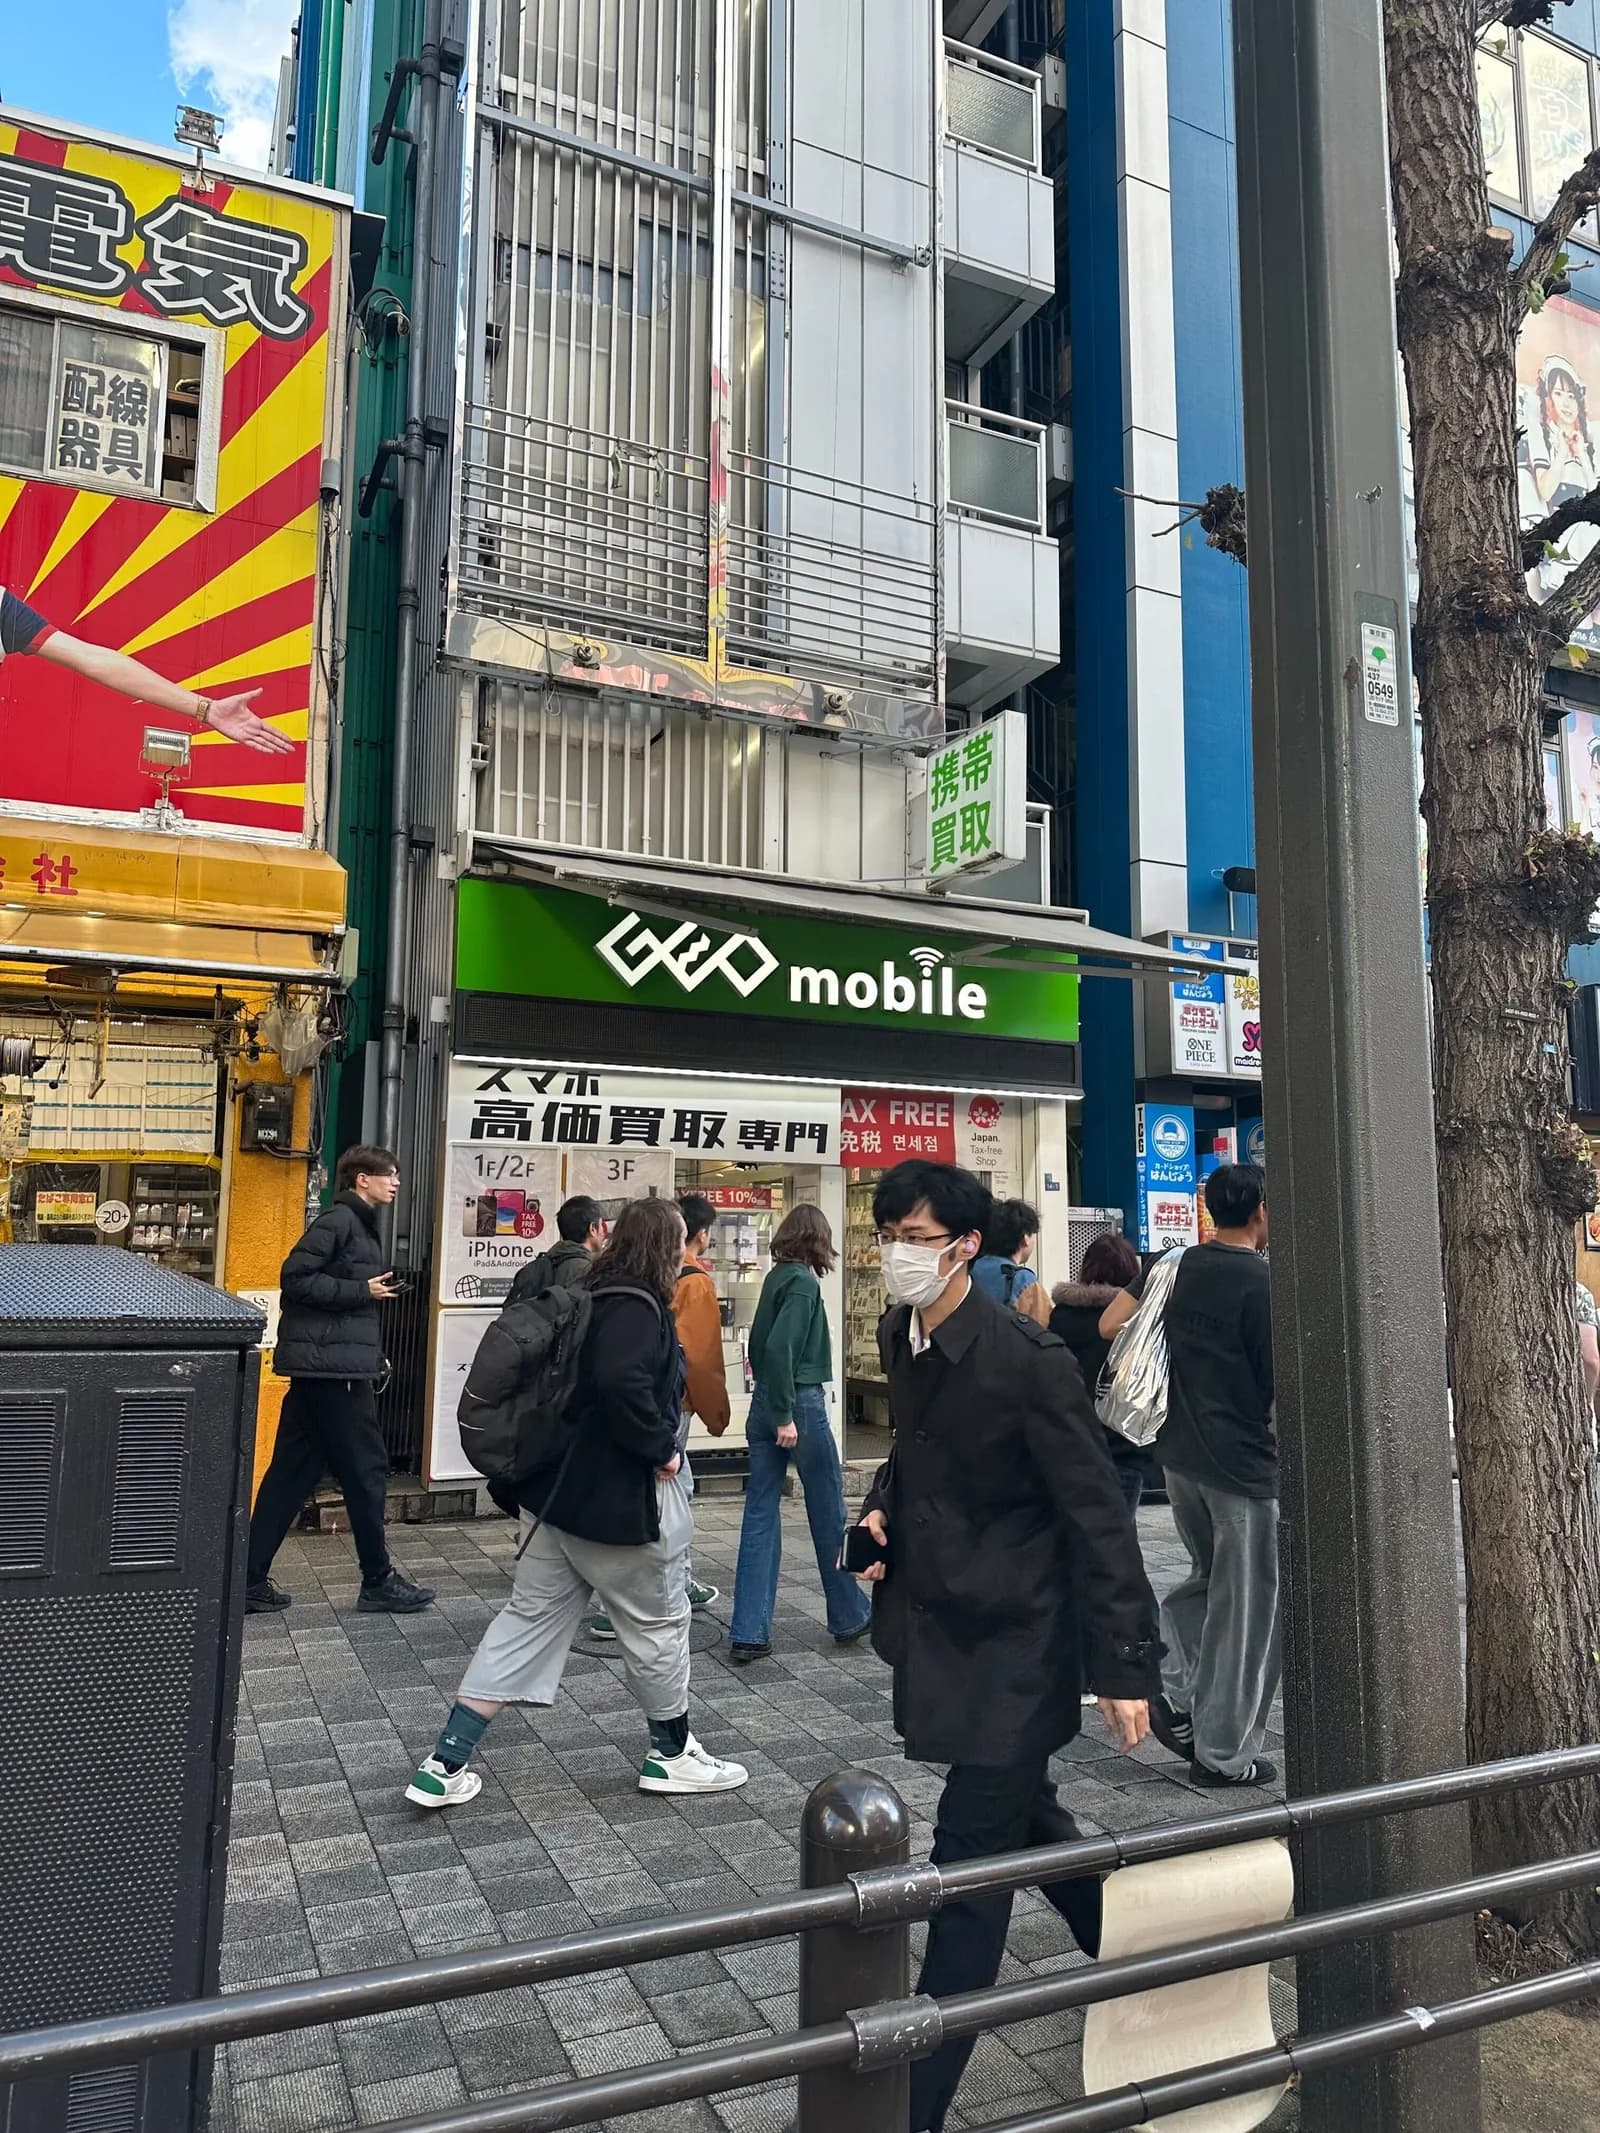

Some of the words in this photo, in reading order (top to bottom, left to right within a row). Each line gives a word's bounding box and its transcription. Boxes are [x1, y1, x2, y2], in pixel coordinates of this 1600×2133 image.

[0, 156, 313, 341] 電気
[63, 362, 150, 428] 配線
[59, 418, 143, 482] 器具
[1368, 681, 1394, 699] 0549
[931, 730, 993, 812] 携帯
[930, 800, 992, 874] 買取
[0, 853, 79, 896] 社
[596, 911, 780, 998] GEO
[790, 958, 988, 1020] mobile
[1187, 1038, 1213, 1051] ONE
[1185, 1050, 1216, 1063] PIECE
[475, 1066, 600, 1096] スマホ
[889, 1100, 950, 1127] FREE
[469, 1098, 829, 1155] 高価買取専門
[1136, 1107, 1145, 1154] TCG
[840, 1130, 882, 1154] 免税
[892, 1134, 938, 1153] 면세점
[969, 1145, 1003, 1156] Tax-free
[474, 1154, 536, 1181] 1F/2F
[607, 1159, 636, 1181] 3F
[975, 1157, 997, 1167] Shop
[1150, 1170, 1193, 1182] はんじょう
[728, 1190, 757, 1204] 10%
[103, 1209, 128, 1223] 20+
[521, 1212, 536, 1221] TAX
[521, 1220, 537, 1228] FREE
[521, 1228, 537, 1237] 10%
